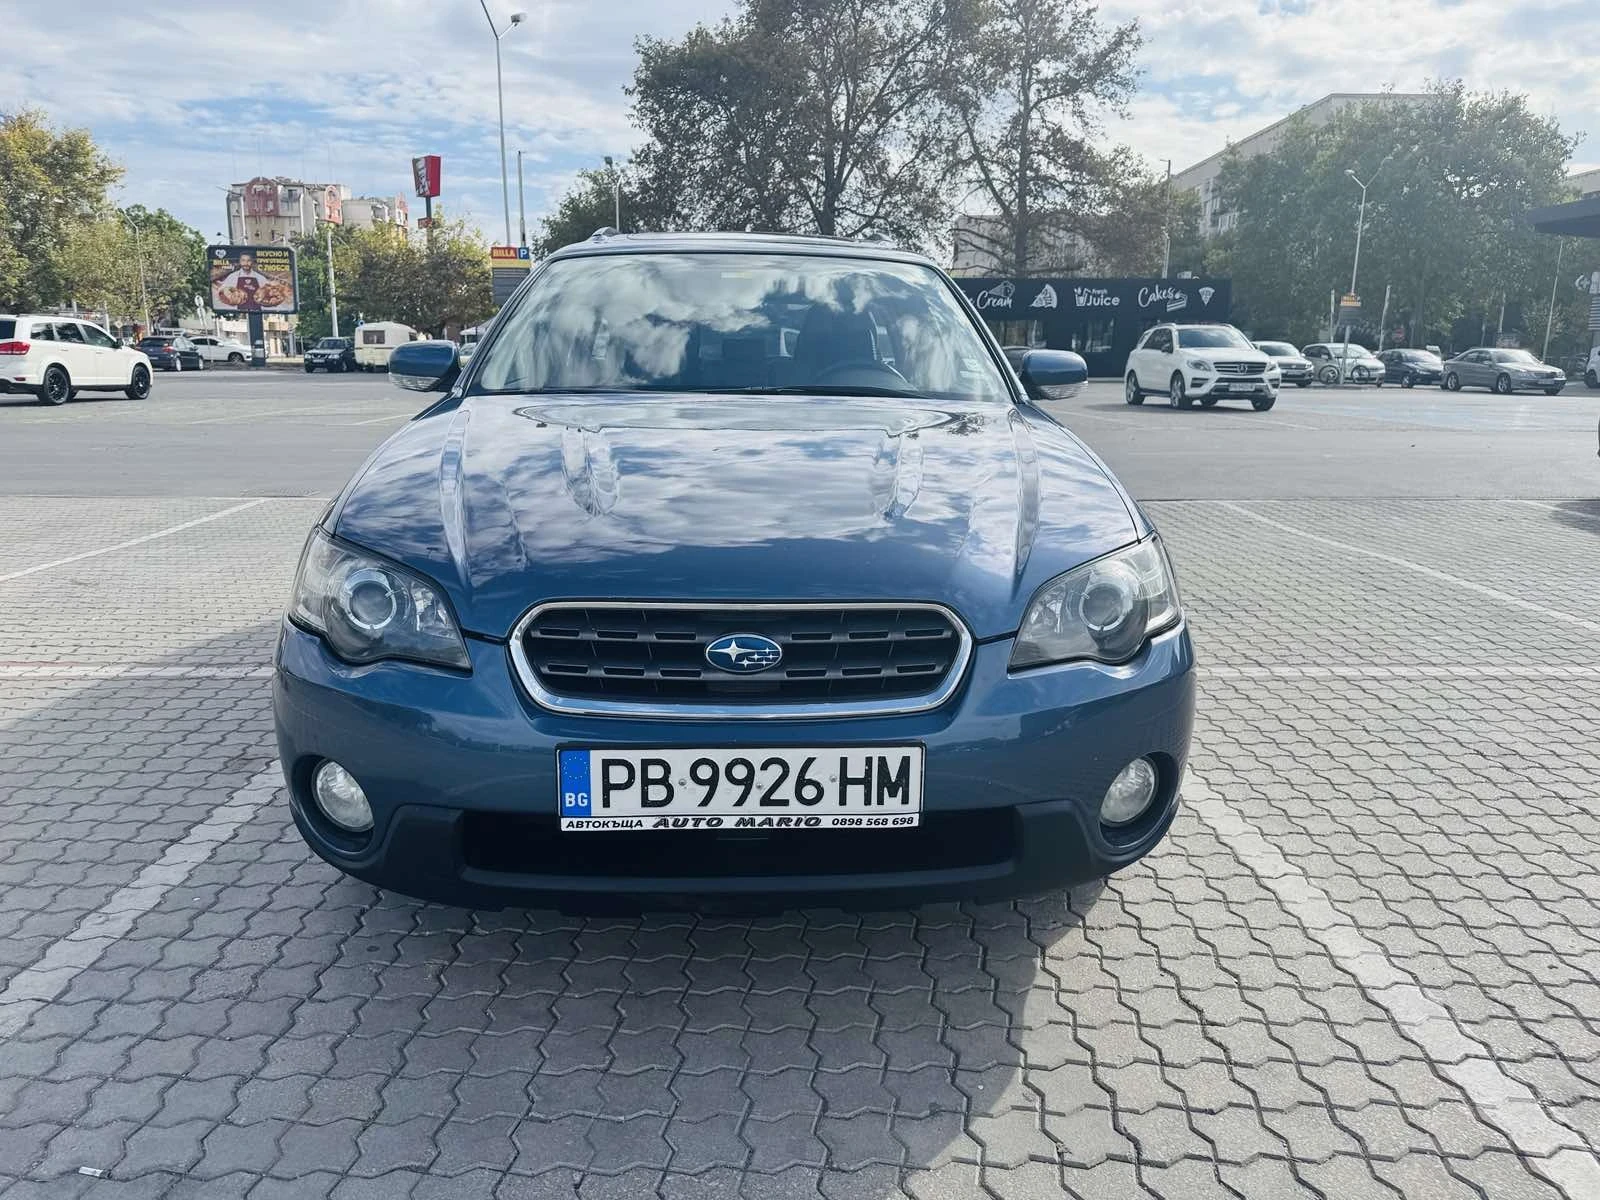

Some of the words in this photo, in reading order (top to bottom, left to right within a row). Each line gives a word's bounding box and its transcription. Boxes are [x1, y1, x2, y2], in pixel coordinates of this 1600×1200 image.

[493, 249, 516, 257] BILLA
[520, 249, 528, 258] P
[977, 290, 1013, 309] Cream
[1086, 294, 1121, 306] Juice
[1138, 284, 1175, 307] Cakes
[602, 758, 675, 808] PB
[689, 757, 825, 807] 9926
[839, 756, 910, 806] HM
[565, 792, 588, 807] BG
[566, 820, 644, 829] АВТОКЪЩА
[652, 817, 724, 828] AUTO
[734, 816, 822, 828] MARIO
[831, 818, 863, 826] 0898
[866, 818, 889, 826] 568
[892, 816, 914, 826] 698
